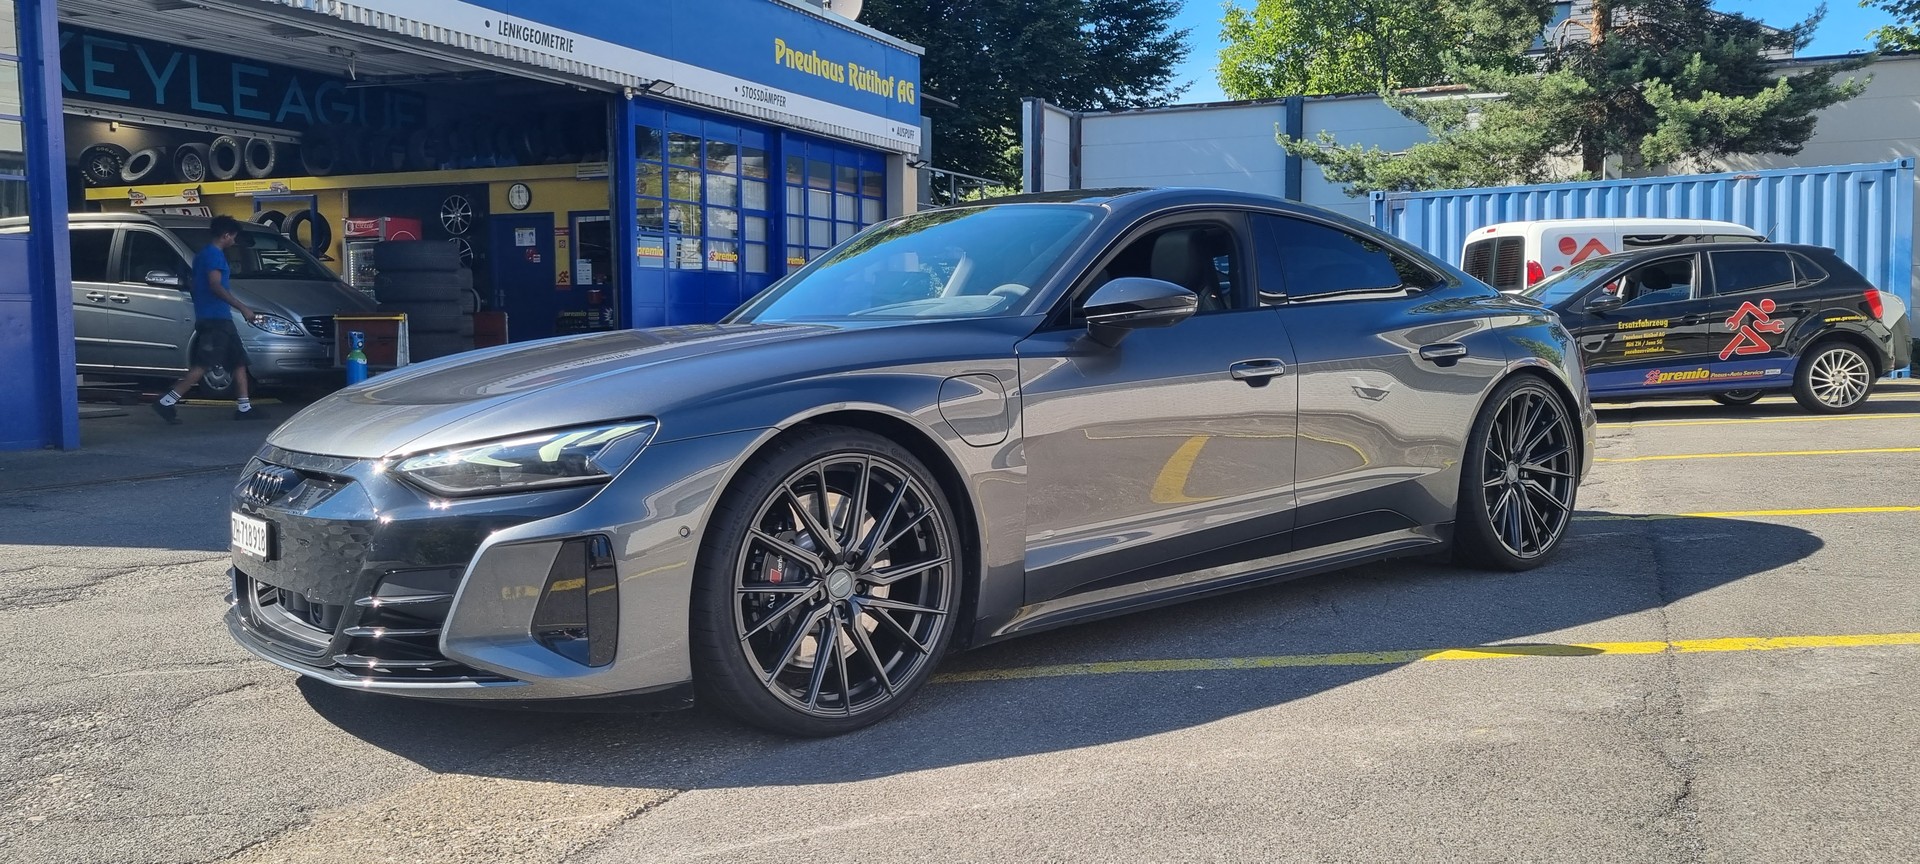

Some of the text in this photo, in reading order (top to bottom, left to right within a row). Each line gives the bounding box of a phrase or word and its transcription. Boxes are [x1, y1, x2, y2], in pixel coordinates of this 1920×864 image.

[498, 20, 574, 53] LENKGEOMETRIE
[775, 37, 915, 105] Pneuhaus Rütihof AG
[742, 85, 787, 107] STOSSDÄMPFER
[897, 126, 915, 139] AUSPUFF
[637, 246, 664, 257] premio
[714, 252, 738, 261] premio
[1618, 319, 1669, 330] Ersatzfahrzeug
[1657, 367, 1710, 384] premio
